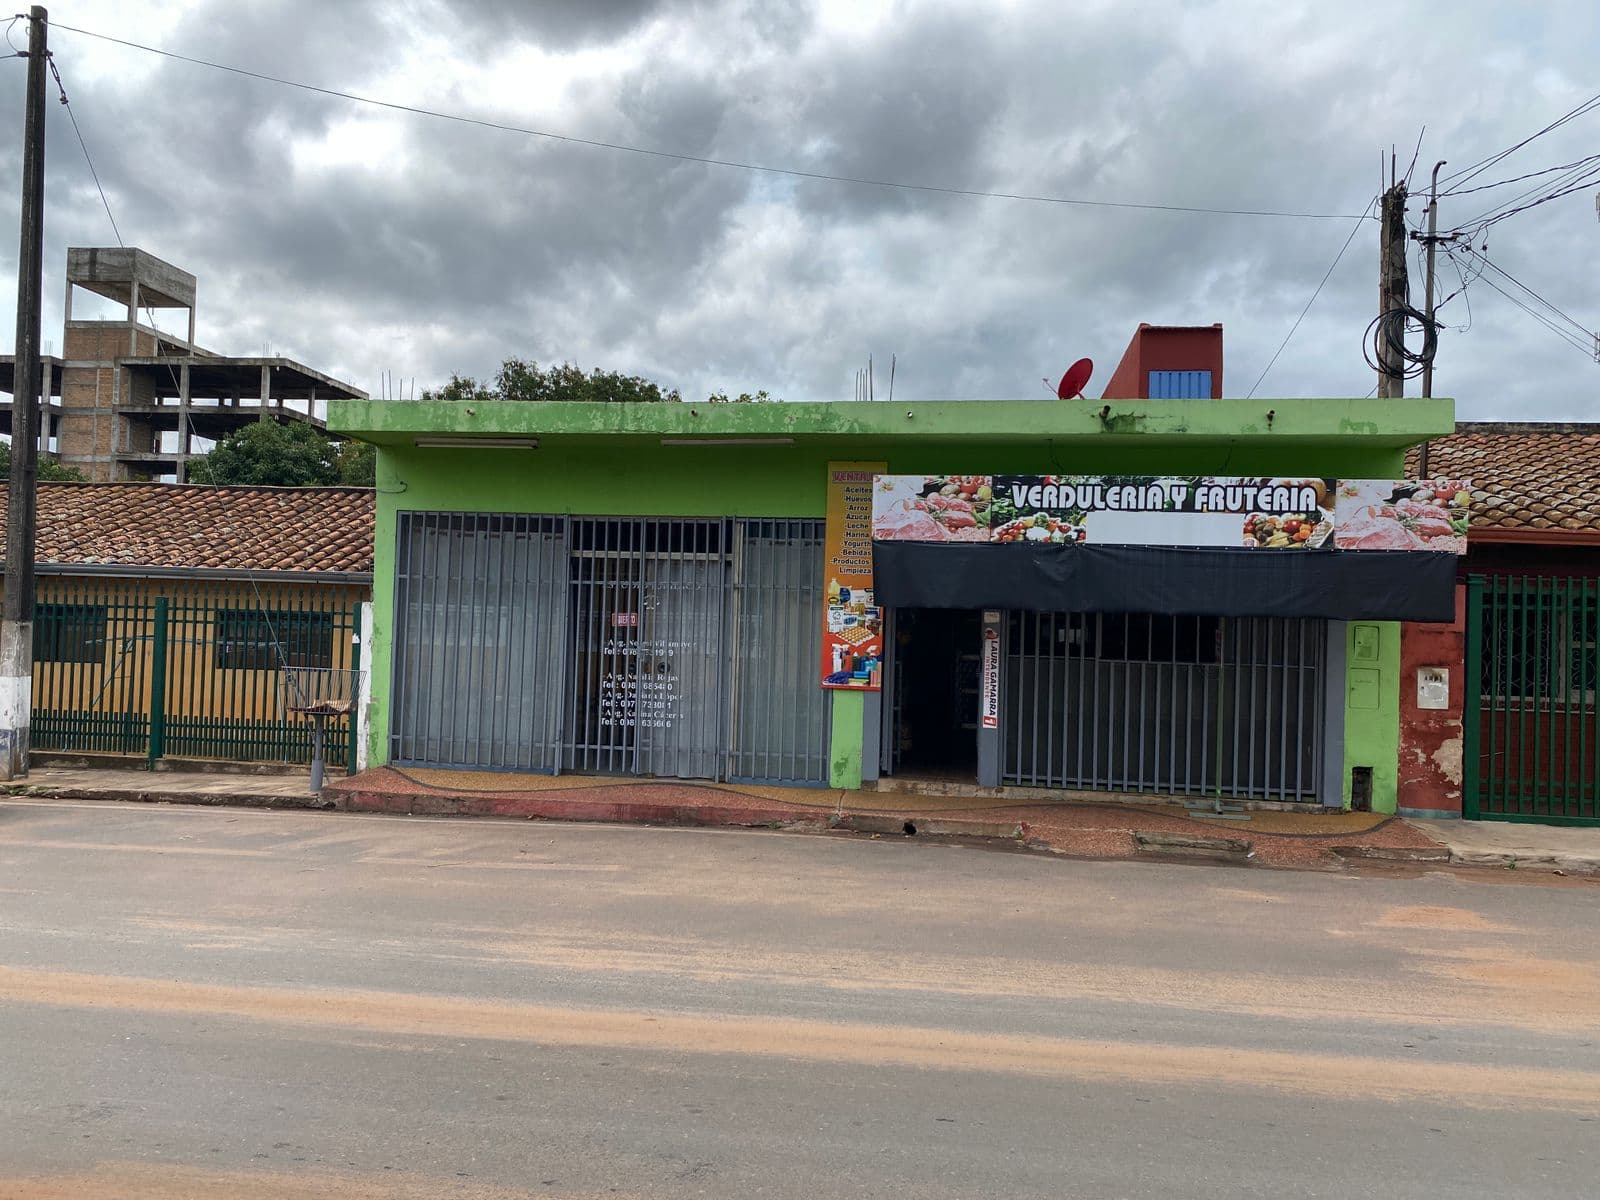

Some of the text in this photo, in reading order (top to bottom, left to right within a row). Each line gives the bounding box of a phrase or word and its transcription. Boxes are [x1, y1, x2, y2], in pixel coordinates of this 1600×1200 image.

[1011, 484, 1317, 513] VERDULERIA Y FRUTERIA
[839, 566, 872, 575] Limpieza
[989, 640, 999, 716] LAURA GAMARRA
